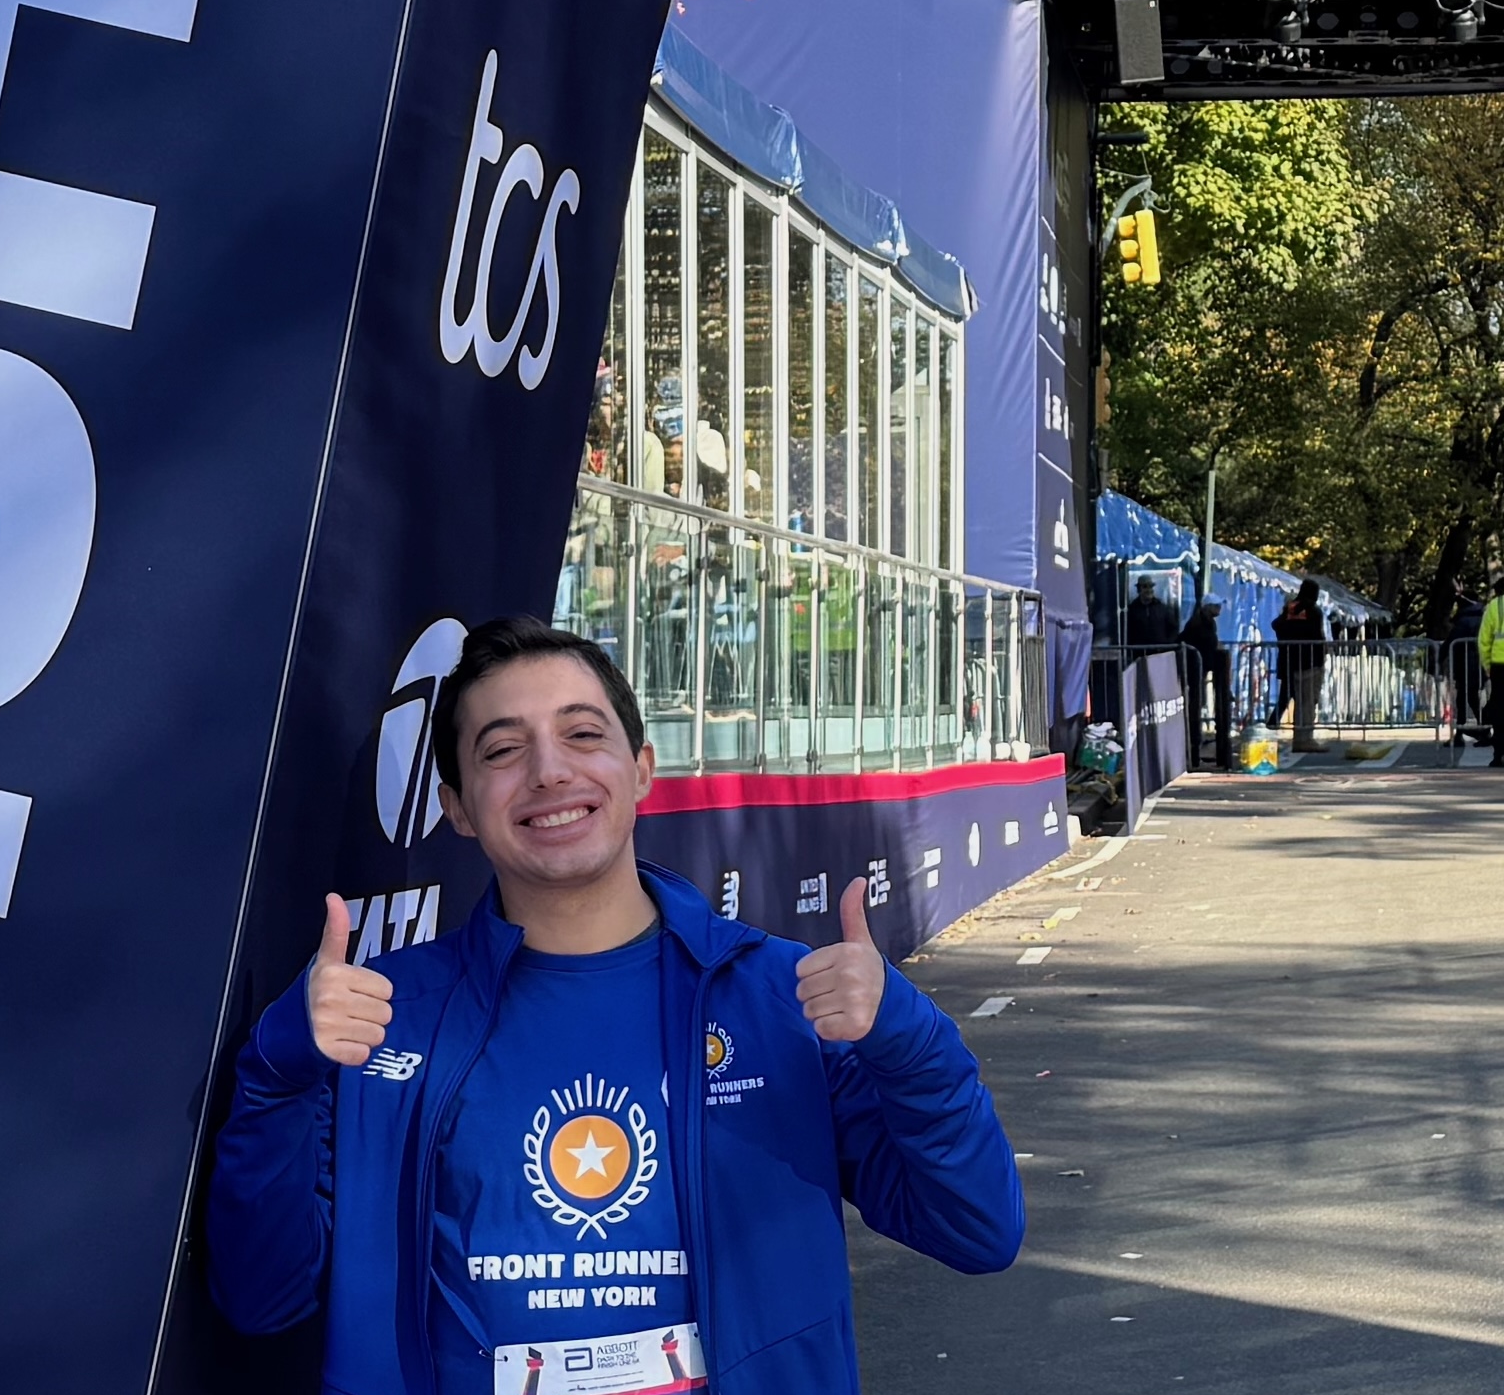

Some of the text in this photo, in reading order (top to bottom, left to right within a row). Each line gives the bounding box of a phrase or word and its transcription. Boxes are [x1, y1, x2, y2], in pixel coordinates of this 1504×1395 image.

[439, 48, 581, 391] tcs
[709, 1076, 765, 1094] RUNNERS
[467, 1253, 565, 1282] FRONT
[528, 1286, 657, 1310] NEW YORK
